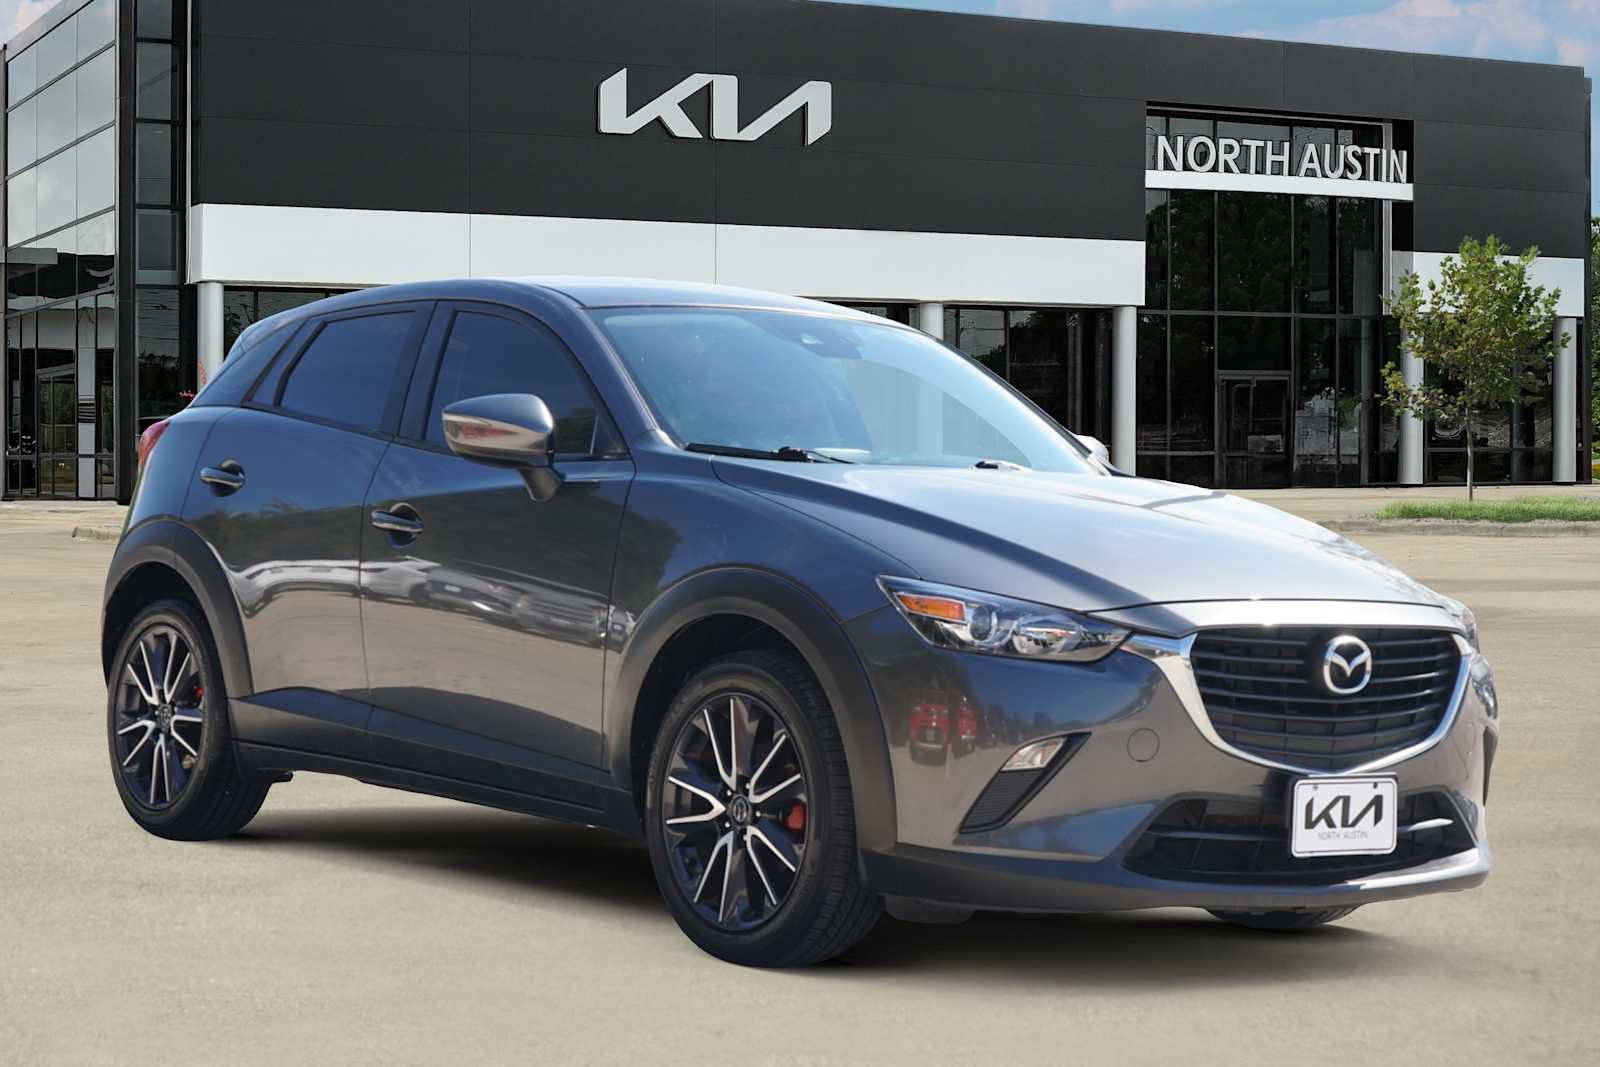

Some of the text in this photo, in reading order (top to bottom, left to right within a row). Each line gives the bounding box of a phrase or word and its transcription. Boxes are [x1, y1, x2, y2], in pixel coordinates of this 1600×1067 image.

[599, 67, 832, 146] KIA
[1157, 135, 1408, 183] NORTH AUSTIN
[1304, 794, 1383, 829] KIA
[1318, 830, 1368, 840] NORTH AUSTIN
